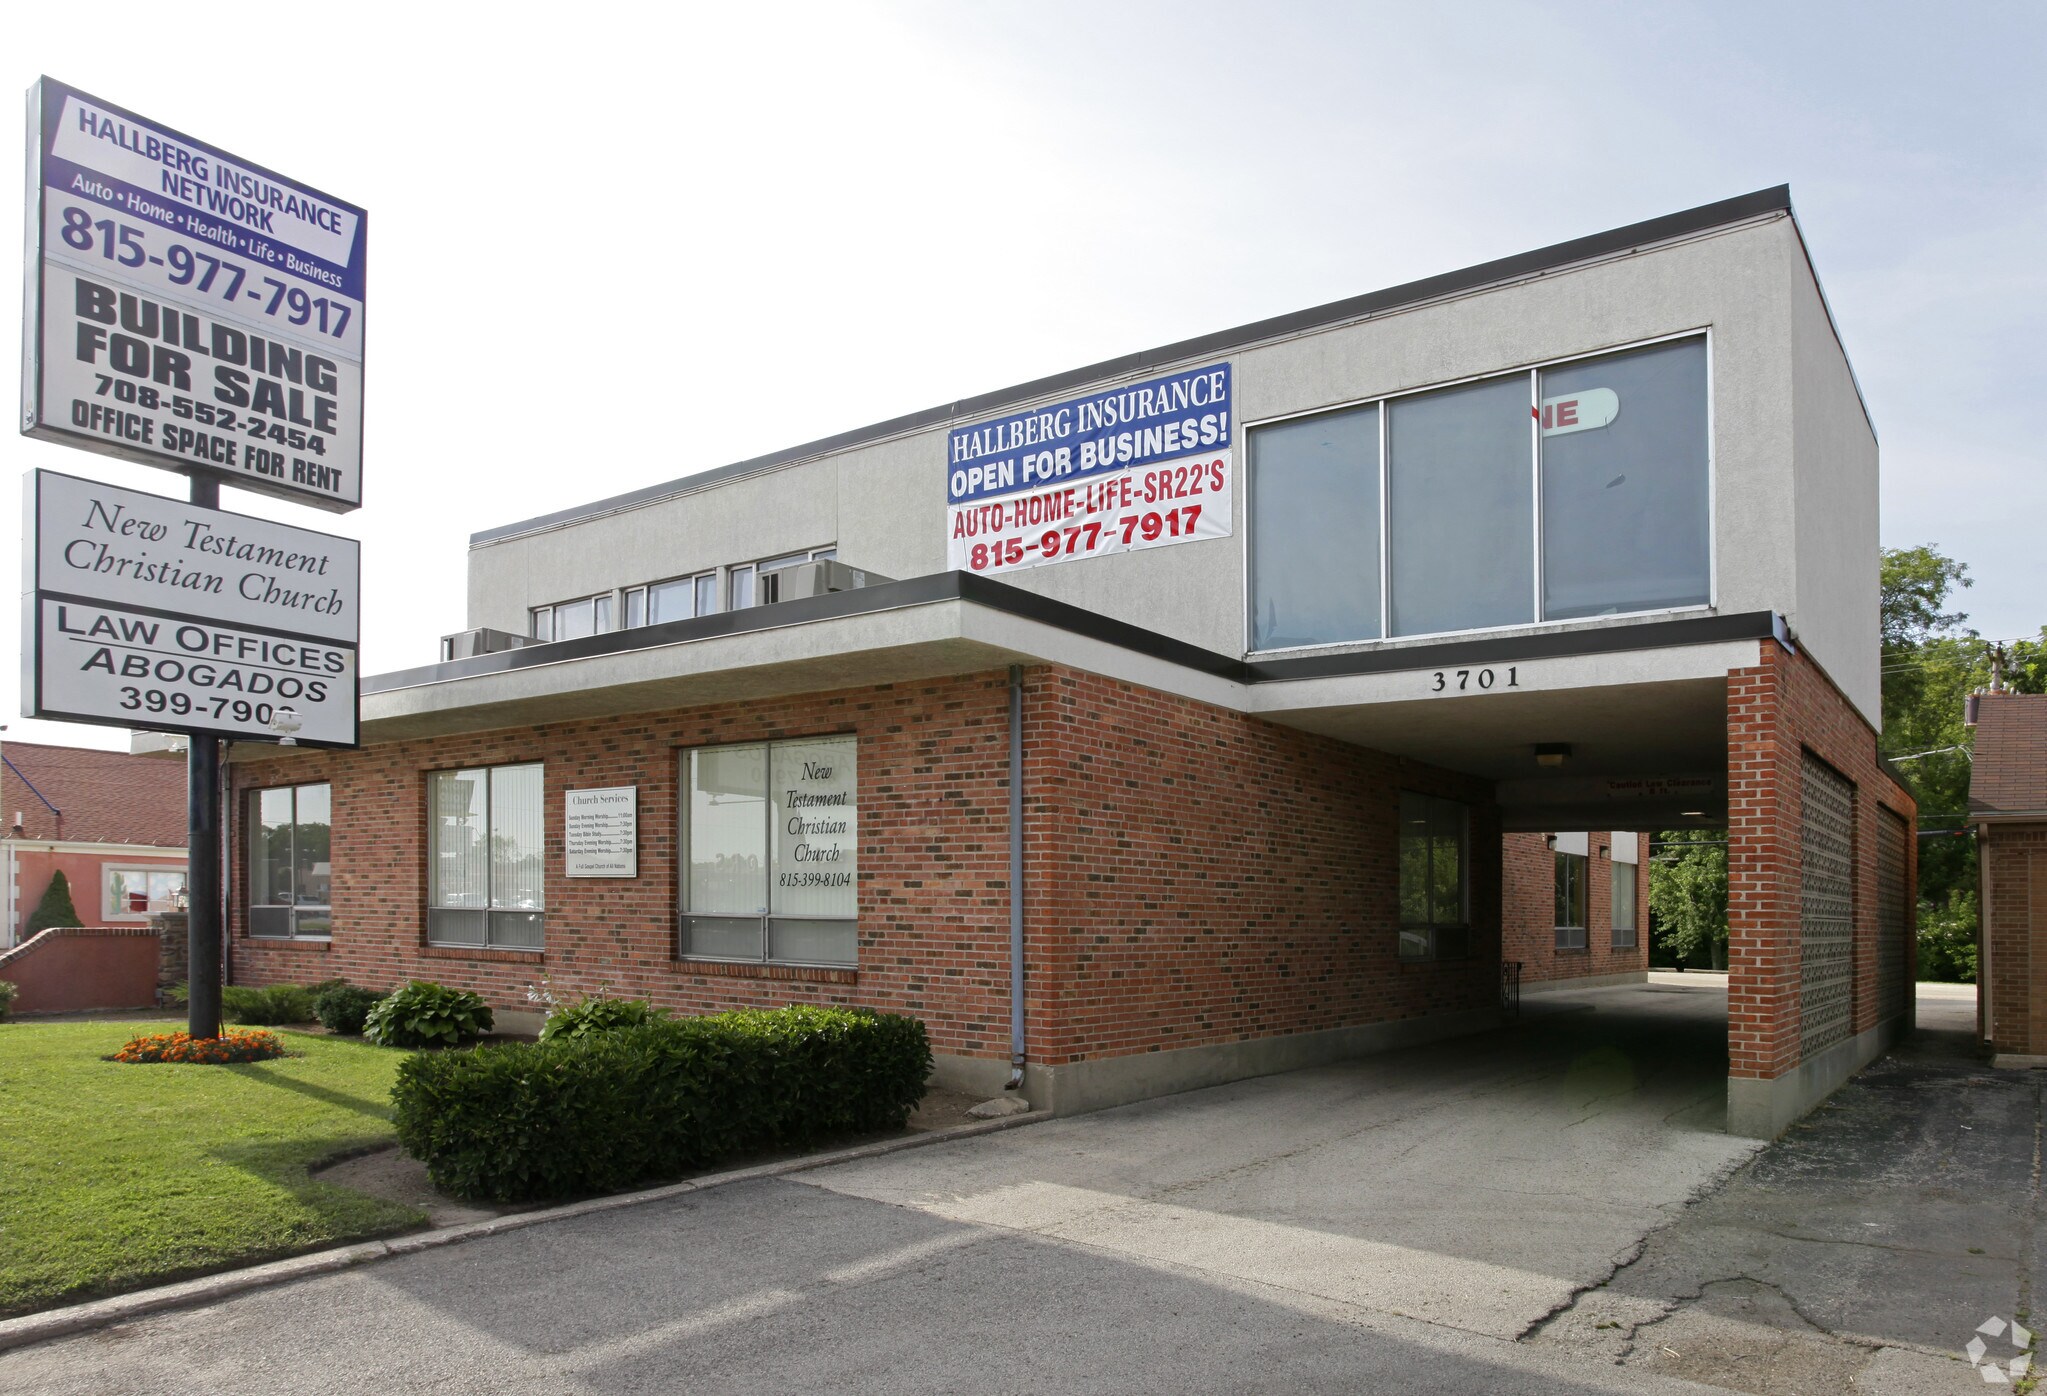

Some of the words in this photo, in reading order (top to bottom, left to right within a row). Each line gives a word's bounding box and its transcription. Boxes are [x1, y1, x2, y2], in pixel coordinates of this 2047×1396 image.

[79, 107, 209, 182] HALLBERG
[216, 164, 343, 236] INSURANCE
[162, 168, 275, 235] NETWORK
[72, 173, 114, 201] Auto
[127, 192, 175, 224] Home
[186, 215, 237, 248] Health
[248, 238, 275, 262] Life
[286, 253, 343, 288] Business
[61, 206, 352, 339] 815-977-7917
[75, 277, 338, 396] BUILDING
[76, 321, 191, 392] FOR
[214, 365, 338, 436] SALE
[72, 398, 154, 445] OFFICE
[163, 422, 237, 467] SPACE
[244, 448, 285, 478] FOR
[292, 460, 342, 493] RENT
[95, 373, 326, 456] 708-552-2454
[952, 408, 1070, 463] HALLBERG
[1077, 370, 1226, 434] INSURANCE
[951, 458, 1014, 498] OPEN
[1023, 447, 1073, 483] FOR
[1080, 412, 1228, 471] BUSINESS!
[82, 499, 168, 542] New
[183, 519, 329, 576] Testament
[970, 504, 1203, 571] 815-977-7917
[64, 539, 224, 594] Christian
[238, 573, 343, 616] Church
[58, 606, 160, 646] LAW
[175, 625, 346, 674] OFFICES
[80, 647, 329, 703] ABOGADOS
[119, 686, 297, 725] 399-790
[1431, 666, 1519, 692] 3701
[572, 795, 599, 805] Church
[600, 794, 629, 804] Services
[786, 790, 847, 809] Testament
[801, 761, 833, 781] New
[787, 816, 847, 835] Christian
[794, 843, 840, 862] Church
[779, 872, 851, 887] 815-399-8104
